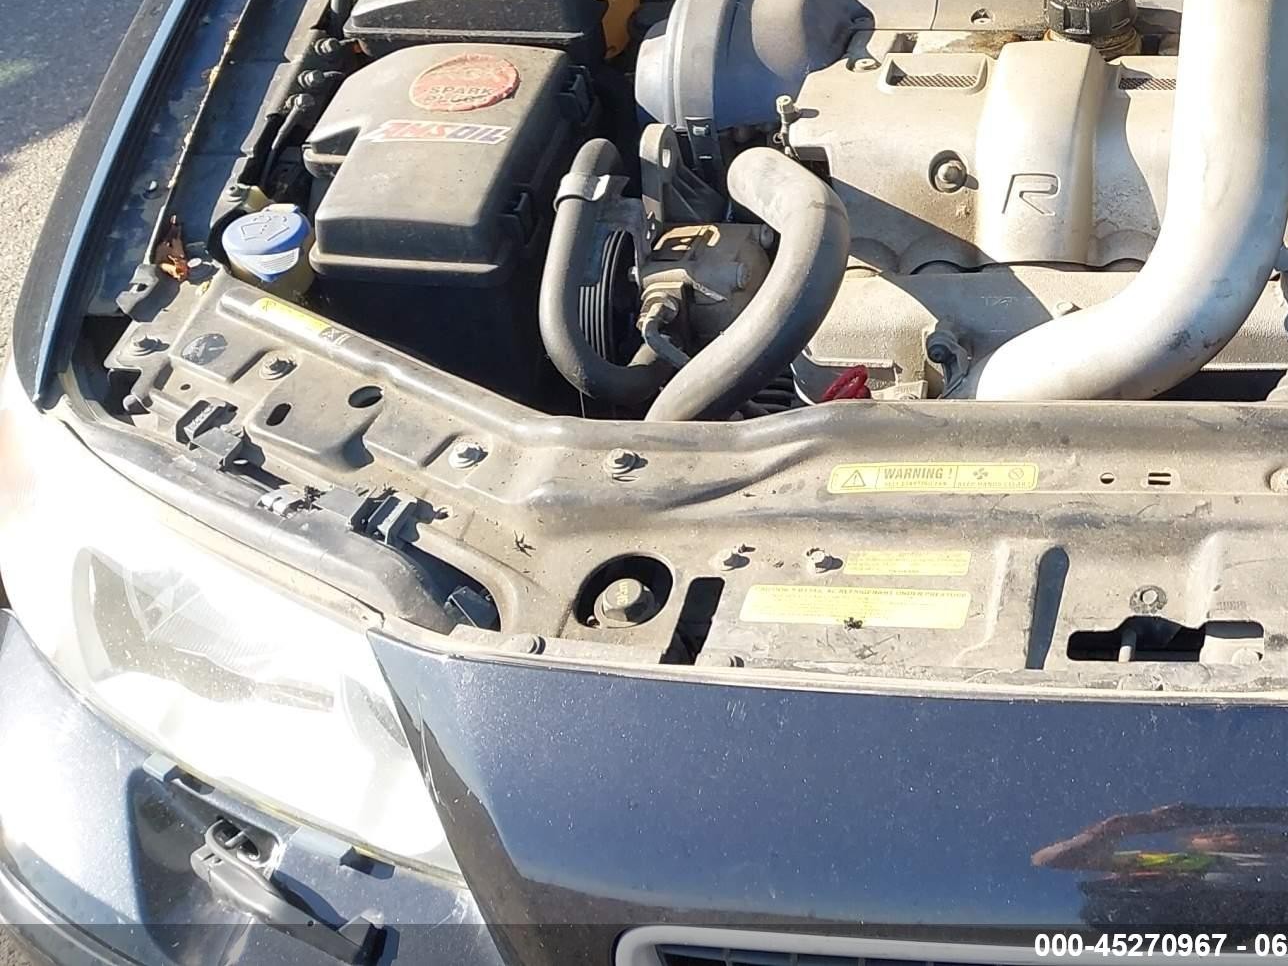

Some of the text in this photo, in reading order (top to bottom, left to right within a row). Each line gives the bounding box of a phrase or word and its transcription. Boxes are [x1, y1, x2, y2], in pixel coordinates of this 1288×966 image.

[429, 85, 495, 96] SPARK
[372, 121, 510, 144] AMSOIL
[1001, 172, 1060, 216] R
[884, 467, 944, 480] WARNING
